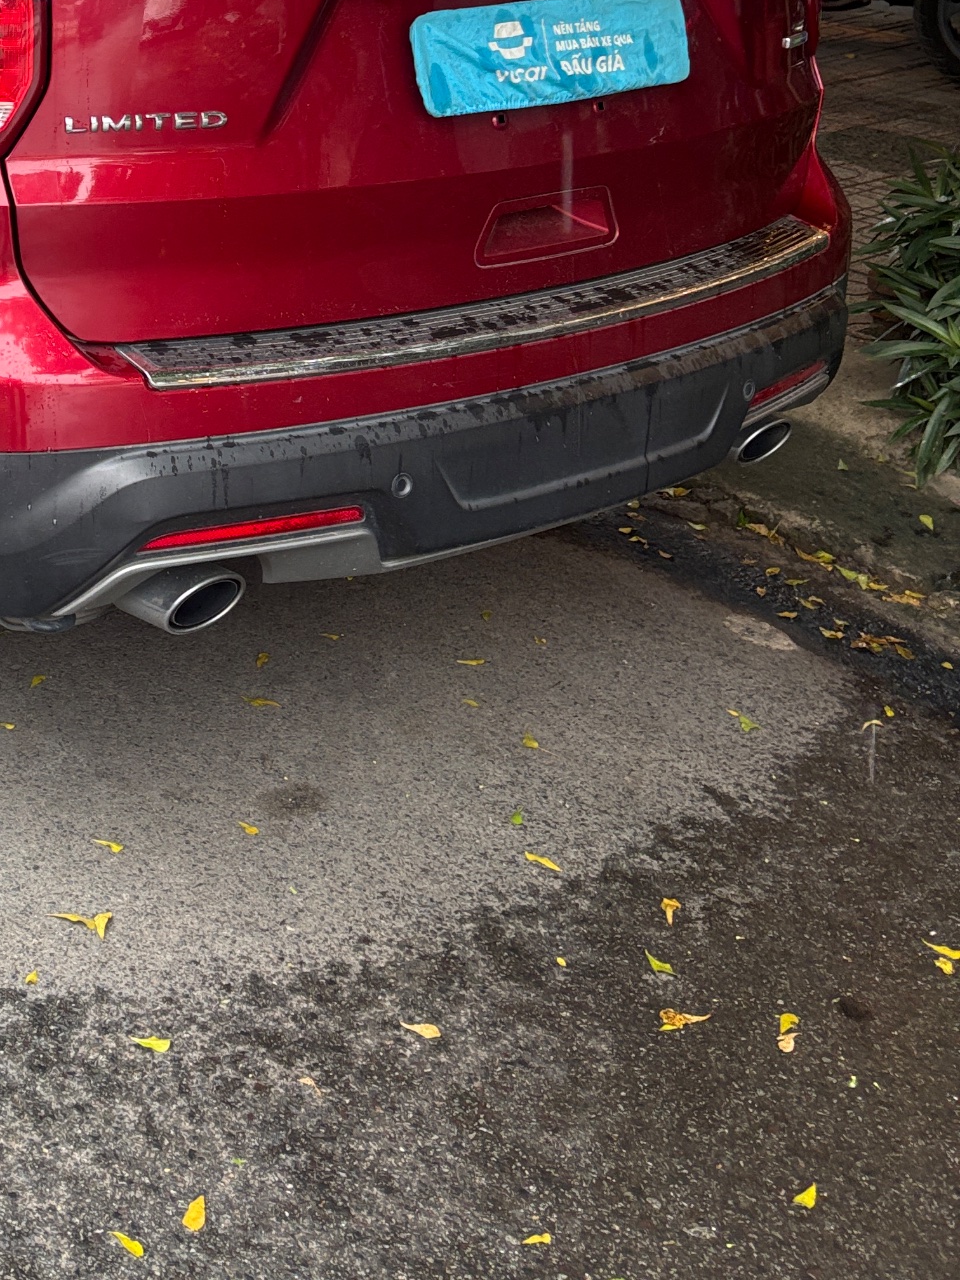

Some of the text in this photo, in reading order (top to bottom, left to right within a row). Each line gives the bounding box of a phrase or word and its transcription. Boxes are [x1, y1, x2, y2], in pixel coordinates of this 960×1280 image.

[555, 34, 634, 52] MUA BÁN XE QUA
[595, 49, 626, 73] GIÁ
[64, 111, 228, 133] LIMITED
